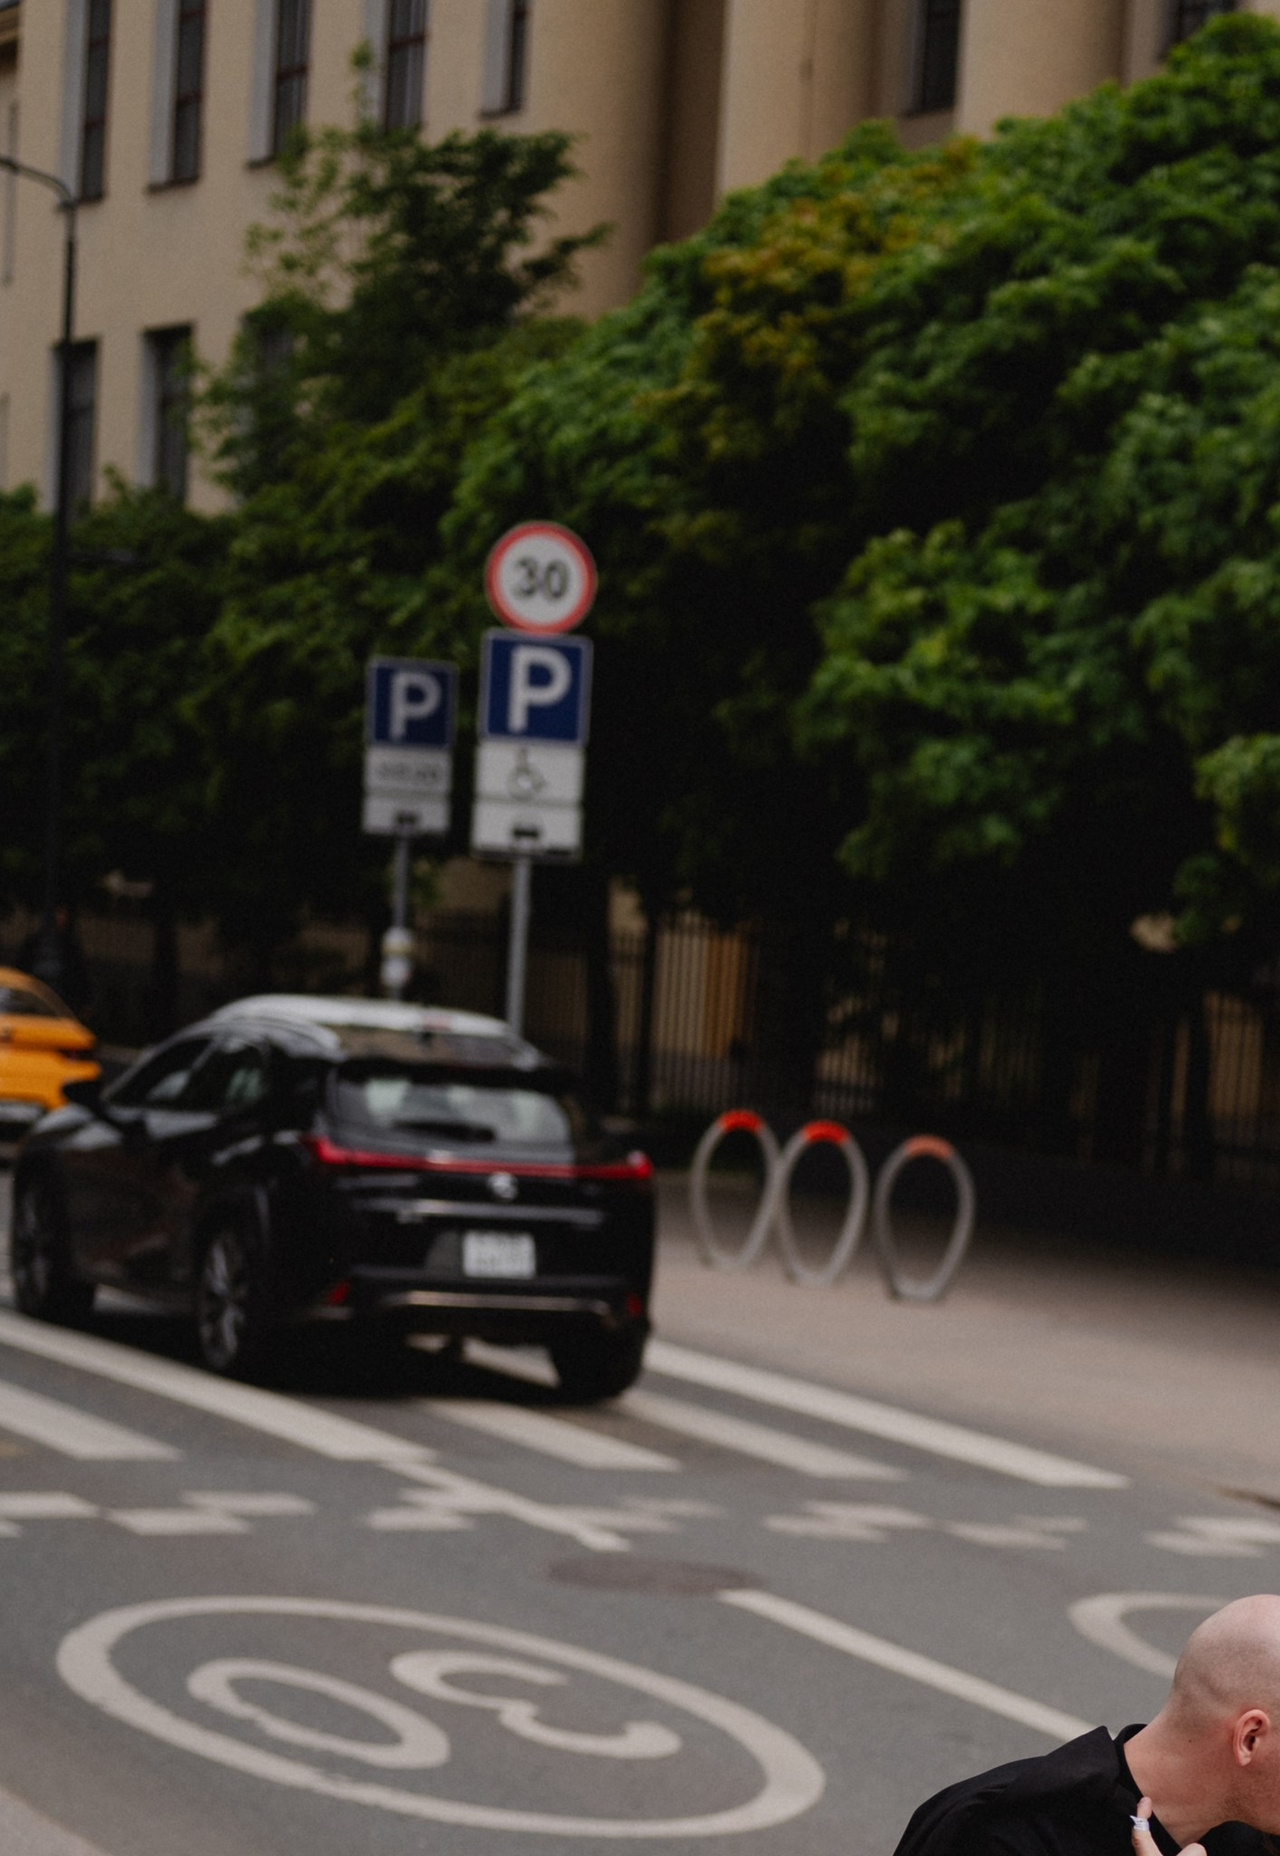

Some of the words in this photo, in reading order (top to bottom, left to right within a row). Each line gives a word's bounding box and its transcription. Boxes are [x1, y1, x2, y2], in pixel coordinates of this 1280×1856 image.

[514, 556, 570, 600] 30
[389, 671, 443, 740] P
[508, 645, 572, 734] P
[187, 1650, 682, 1769] 30
